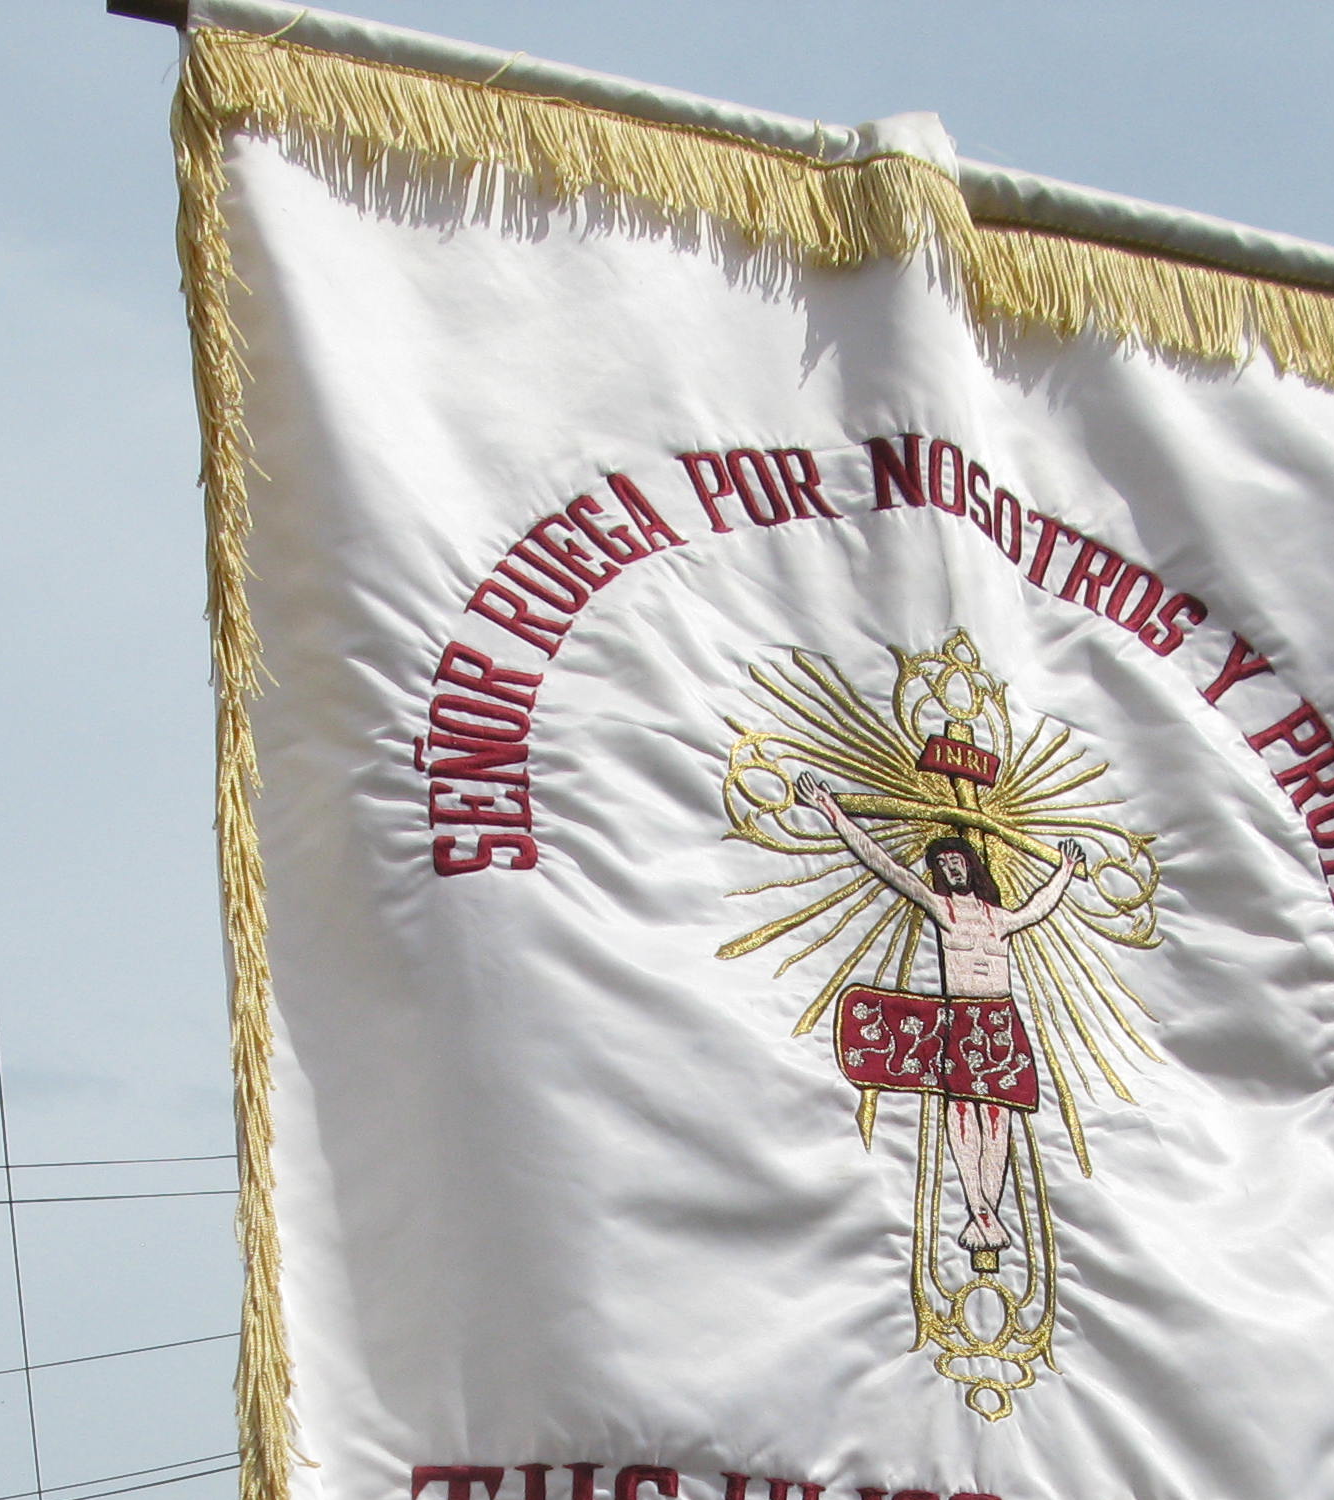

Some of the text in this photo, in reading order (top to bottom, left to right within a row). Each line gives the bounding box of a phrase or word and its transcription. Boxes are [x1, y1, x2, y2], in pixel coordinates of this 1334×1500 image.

[677, 446, 843, 534] POR
[869, 432, 1208, 658] NOSOTROS
[464, 472, 689, 662] RUEGA
[1201, 632, 1274, 707] Y
[412, 639, 544, 878] SEÑOR
[932, 743, 990, 776] INRI
